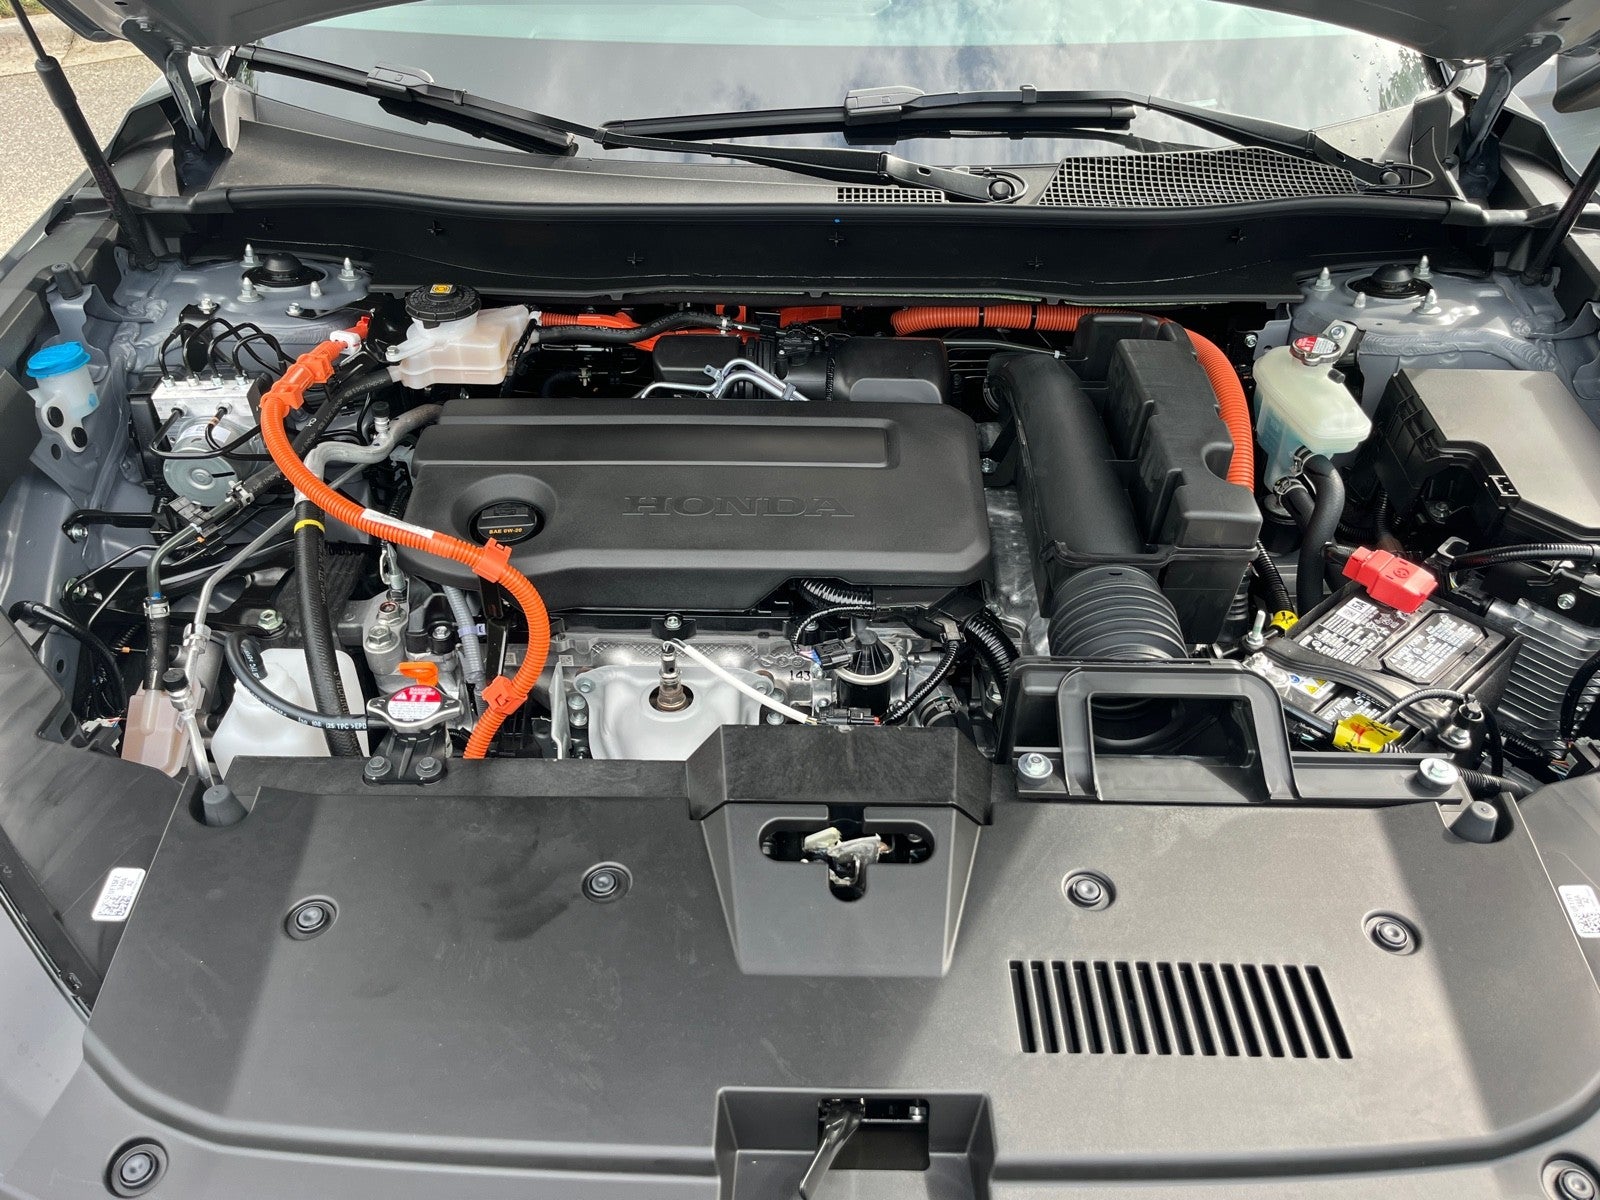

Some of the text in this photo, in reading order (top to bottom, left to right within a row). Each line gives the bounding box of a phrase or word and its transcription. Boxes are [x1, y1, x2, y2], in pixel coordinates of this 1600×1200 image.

[622, 496, 855, 517] HONDA
[789, 670, 811, 681] 143
[337, 722, 349, 730] TPC
